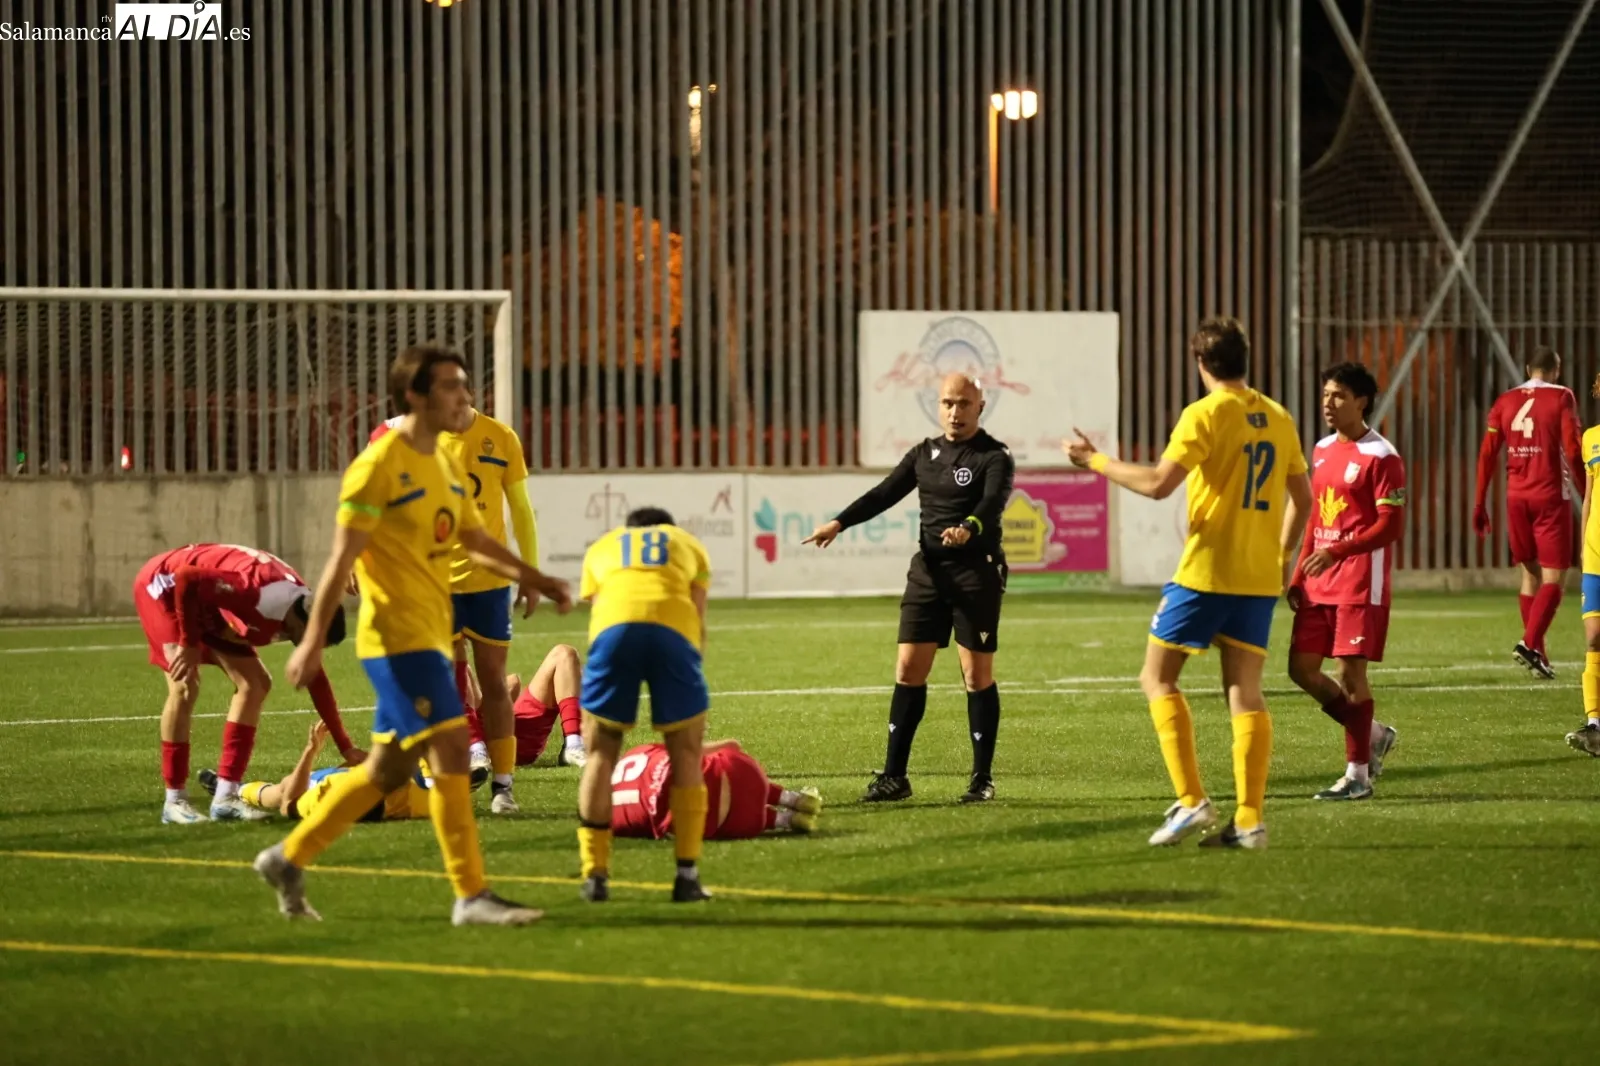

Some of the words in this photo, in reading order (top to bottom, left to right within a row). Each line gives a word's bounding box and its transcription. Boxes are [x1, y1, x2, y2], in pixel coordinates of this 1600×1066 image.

[1511, 397, 1535, 439] 4
[1242, 441, 1275, 511] 12
[619, 531, 670, 569] 18
